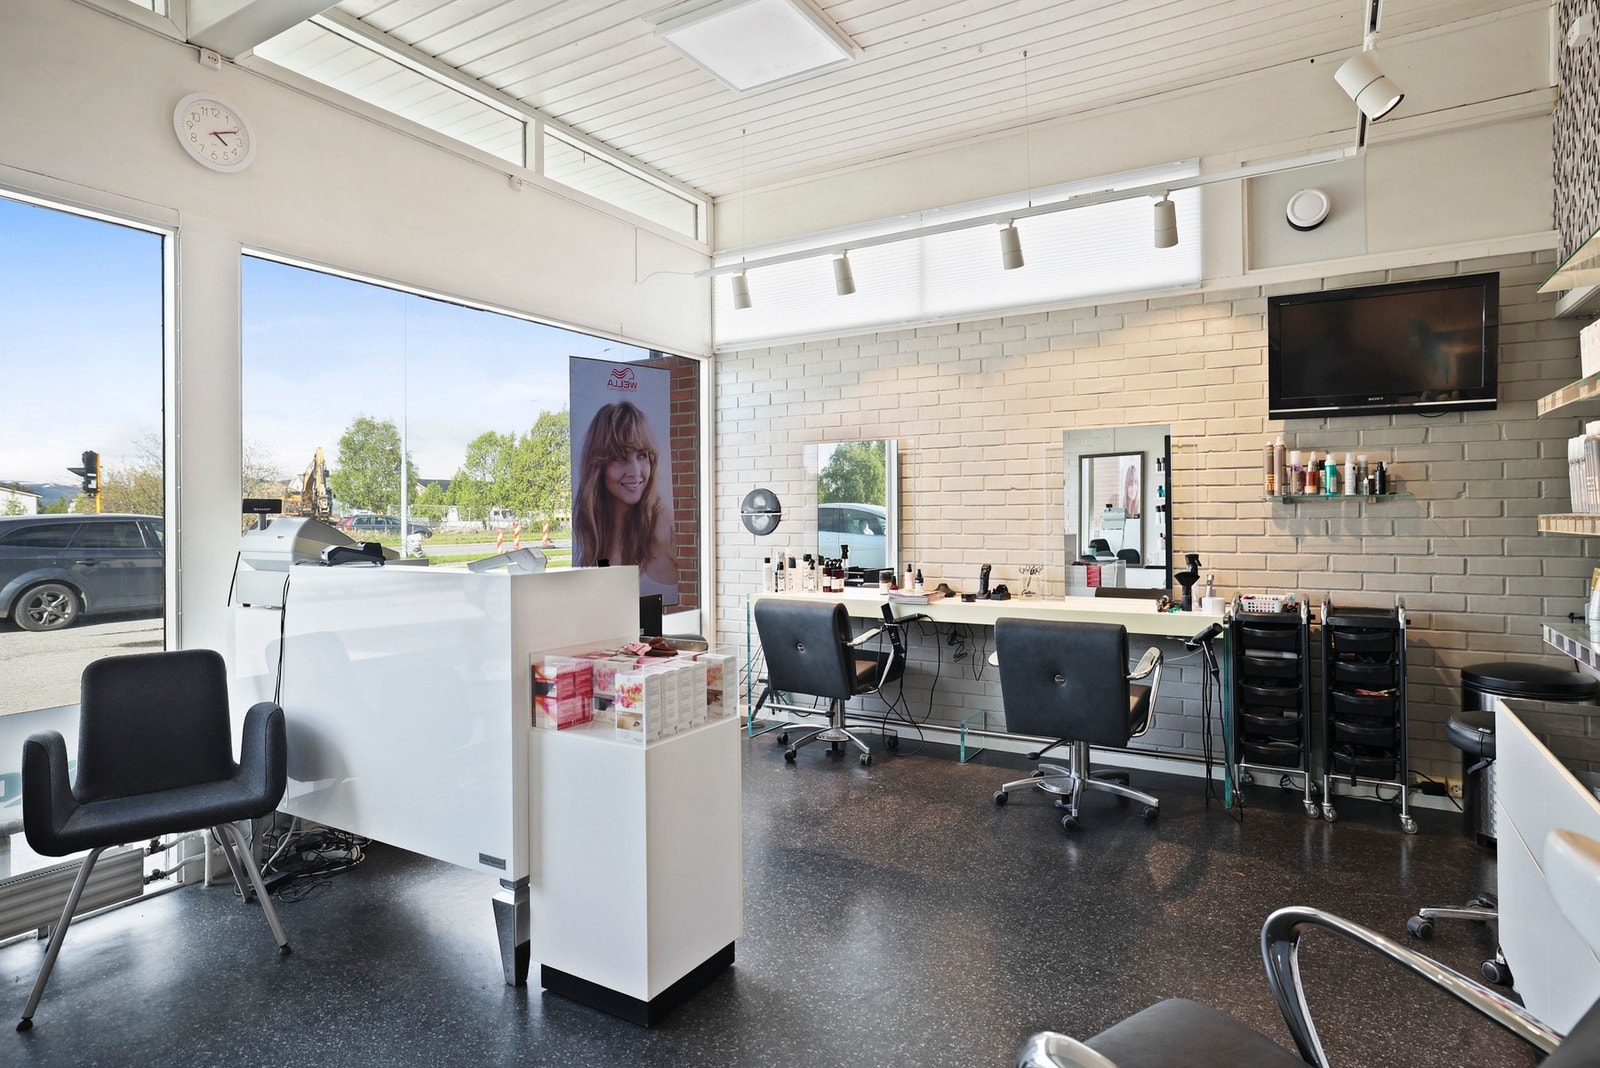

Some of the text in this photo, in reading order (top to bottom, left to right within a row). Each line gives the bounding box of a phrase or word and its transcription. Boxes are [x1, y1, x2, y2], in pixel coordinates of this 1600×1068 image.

[201, 106, 208, 116] 11
[210, 107, 220, 118] 12
[191, 112, 200, 122] 10
[225, 115, 229, 124] 1
[186, 120, 194, 130] 9
[190, 132, 197, 143] 8
[236, 137, 243, 148] 3
[200, 143, 205, 152] 7
[231, 147, 237, 156] 4
[211, 150, 218, 160] 6
[223, 151, 229, 160] 5
